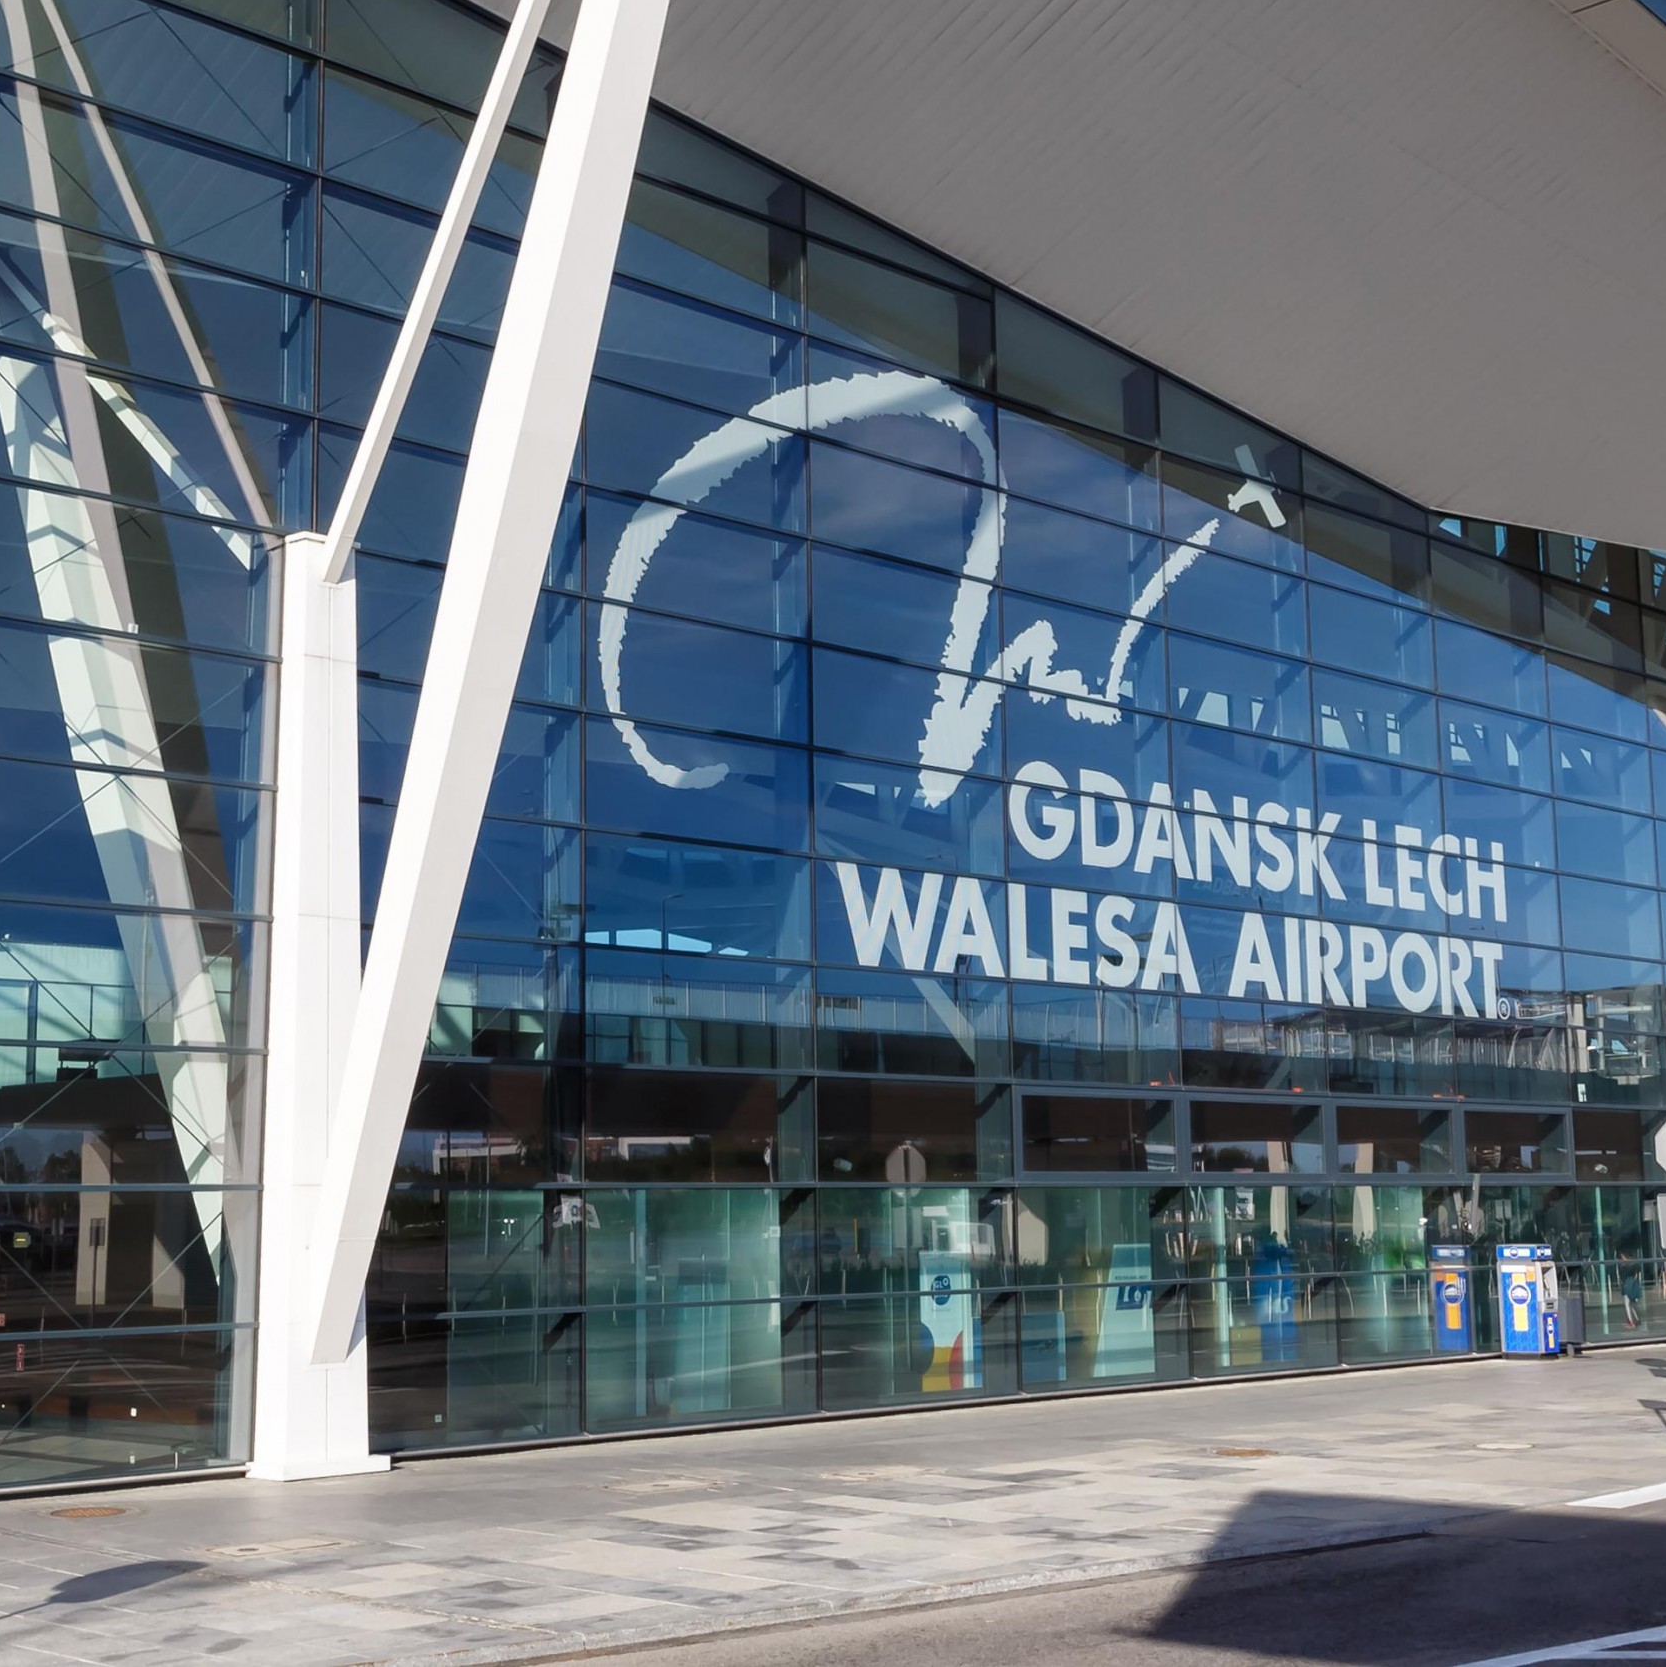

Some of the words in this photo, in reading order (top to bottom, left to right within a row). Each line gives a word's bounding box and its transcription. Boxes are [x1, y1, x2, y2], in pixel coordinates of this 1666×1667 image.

[1362, 819, 1507, 923] LECH
[835, 861, 1202, 995] WALESA
[1229, 912, 1503, 1020] AIRPORT
